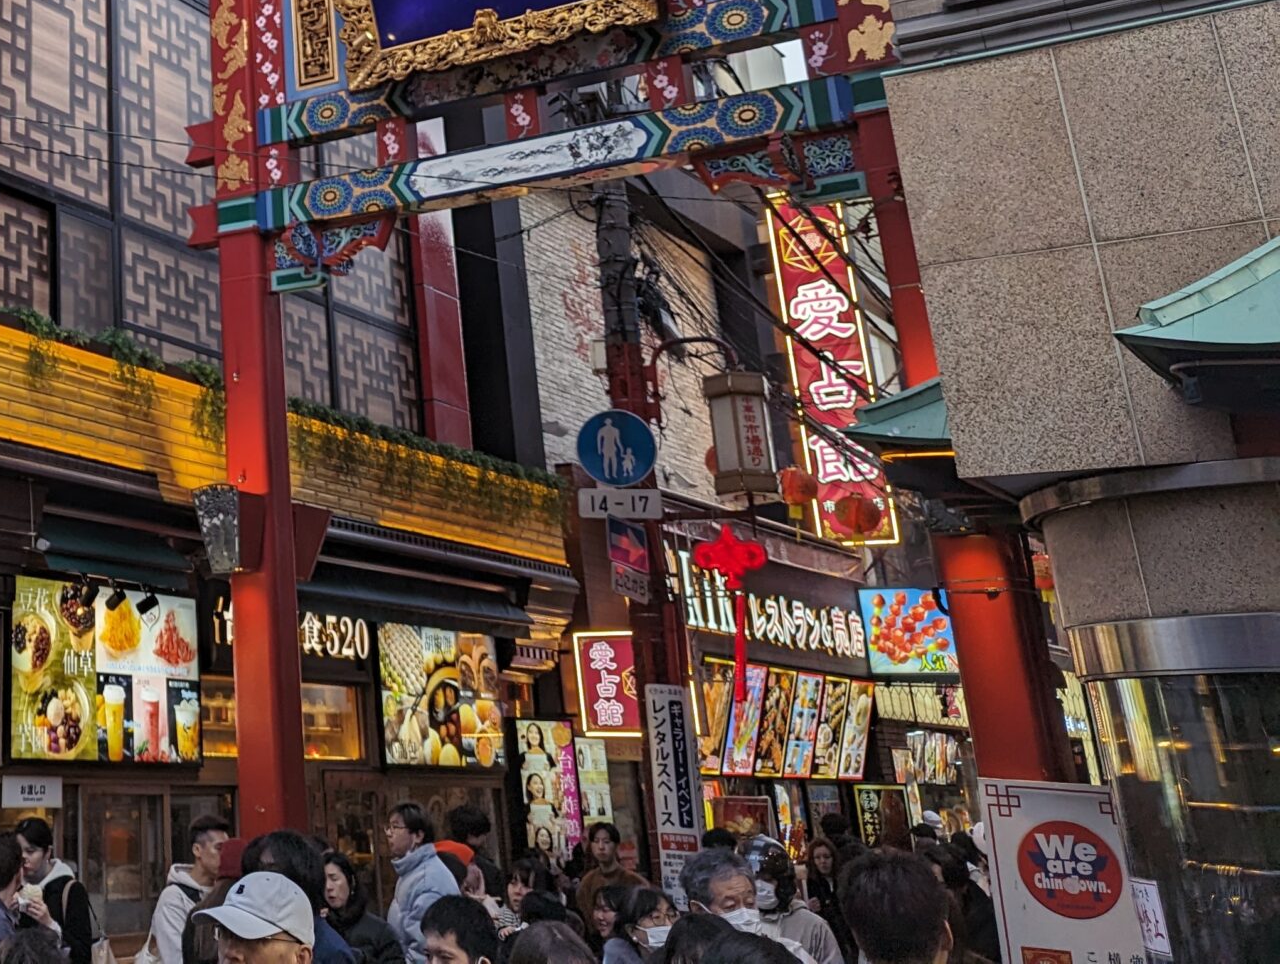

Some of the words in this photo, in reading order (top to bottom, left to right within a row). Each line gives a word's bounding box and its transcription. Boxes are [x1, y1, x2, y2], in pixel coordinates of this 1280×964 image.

[20, 587, 50, 614] 豆花
[62, 648, 94, 677] 仙草
[589, 641, 624, 726] 愛占館
[651, 699, 675, 827] レンタルスペース
[21, 784, 46, 796] お渡し口
[1034, 833, 1097, 862] We
[1046, 859, 1093, 876] are
